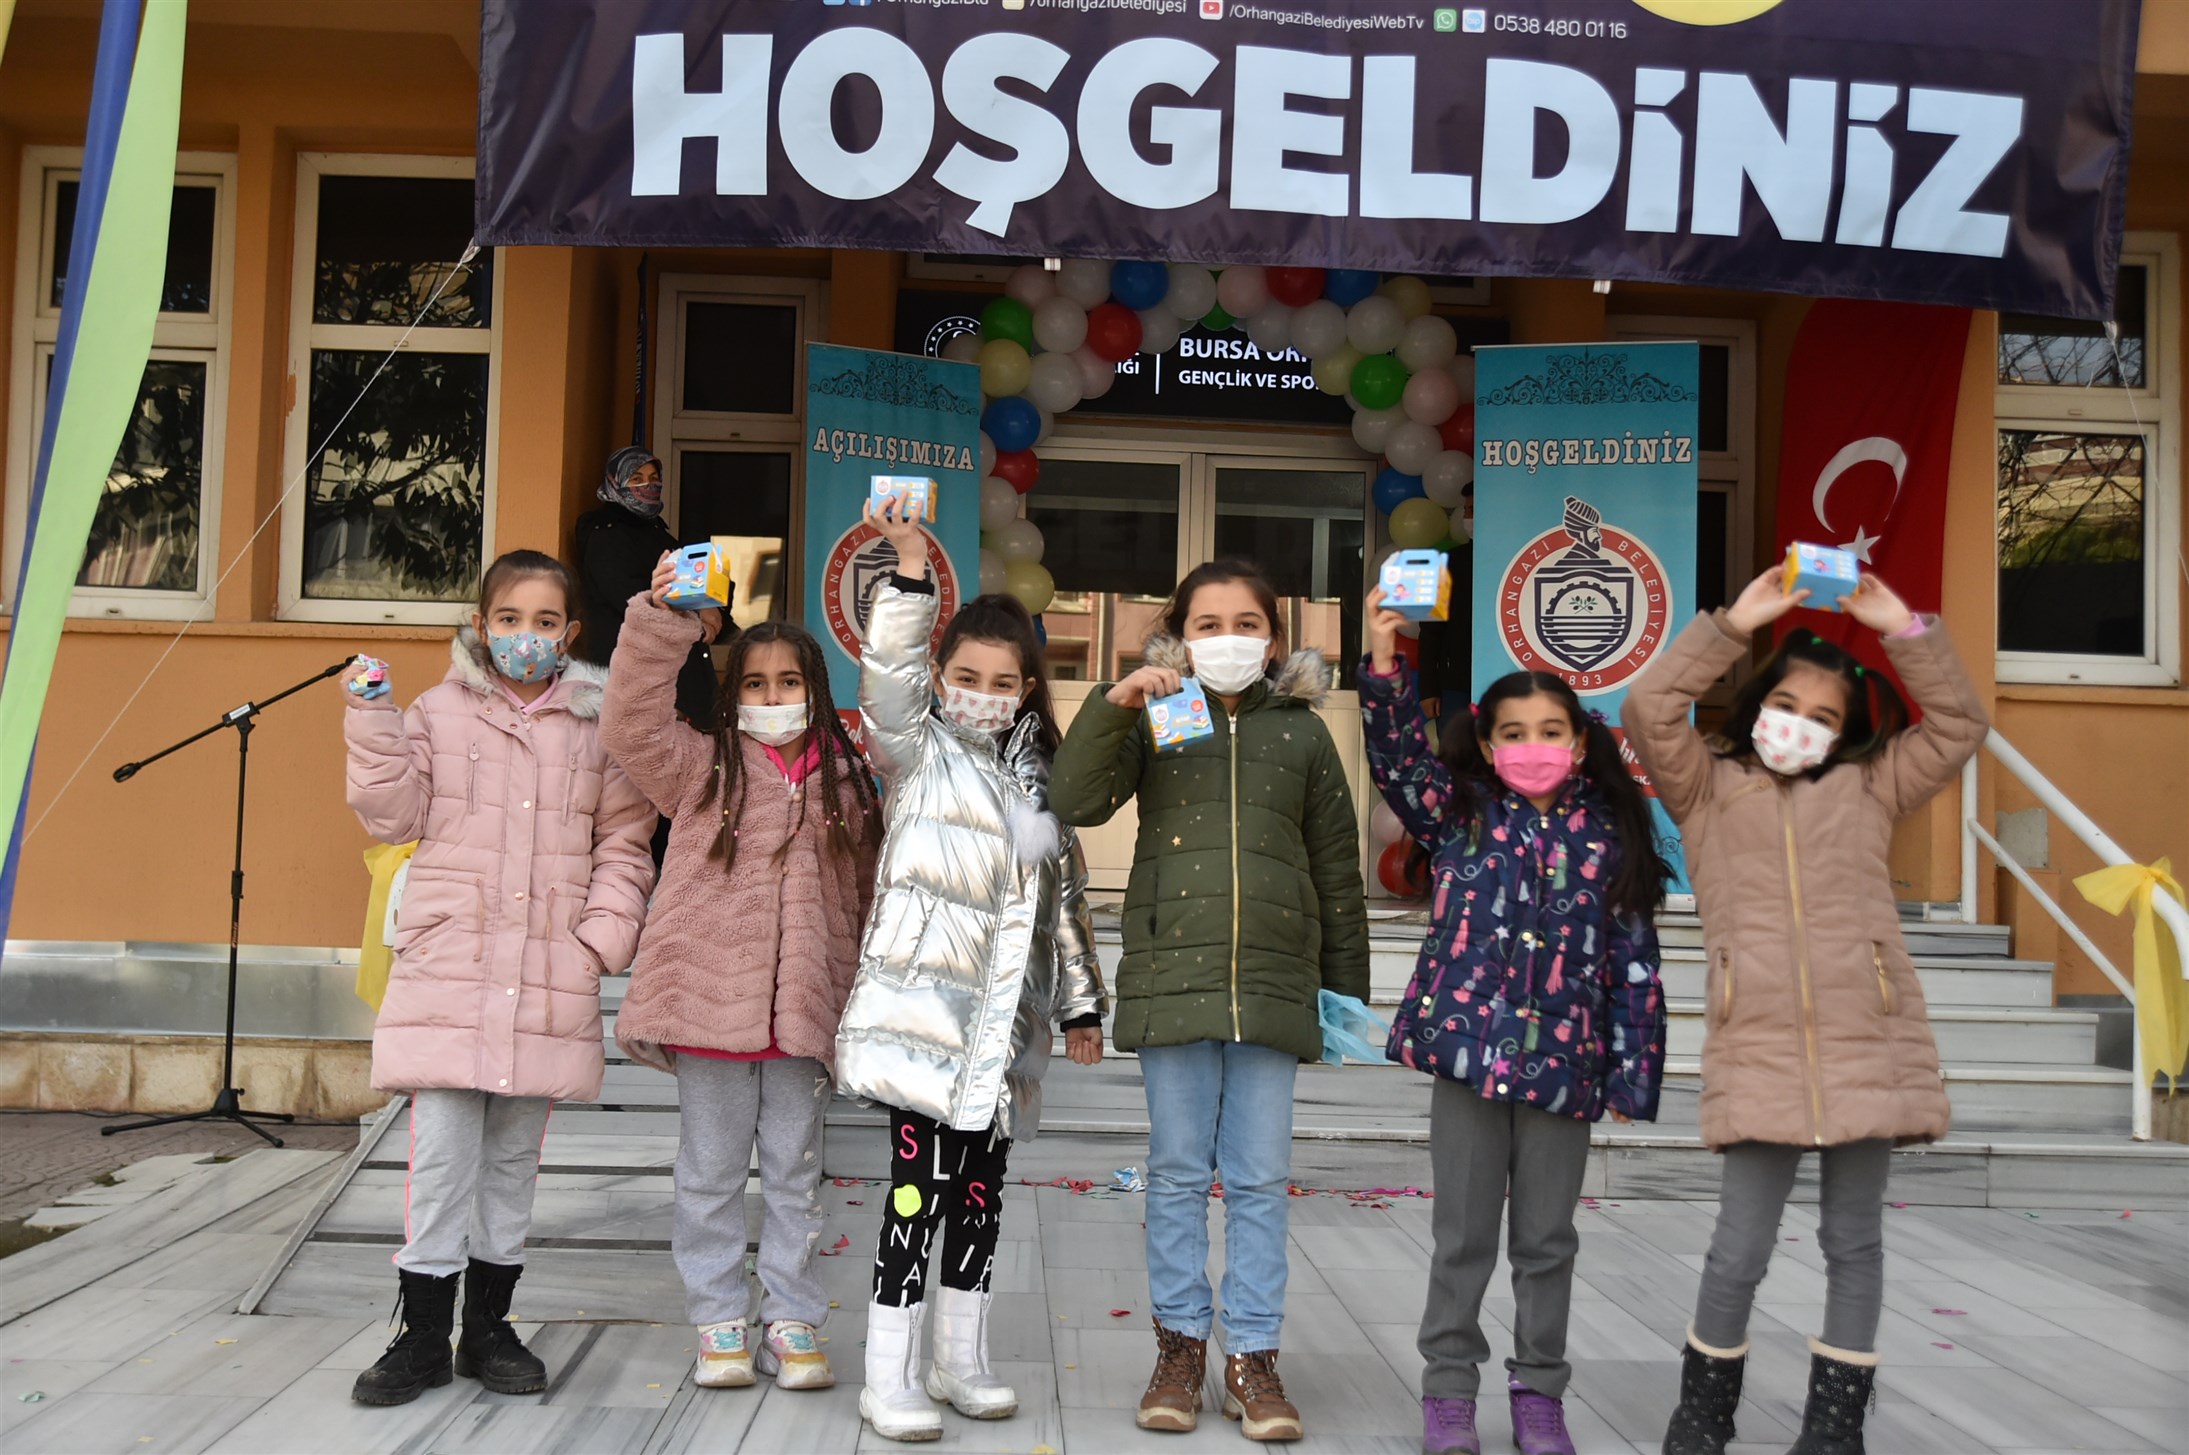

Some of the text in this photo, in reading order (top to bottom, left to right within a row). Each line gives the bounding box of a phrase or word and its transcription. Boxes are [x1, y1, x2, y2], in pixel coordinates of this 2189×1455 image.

[1229, 5, 1424, 32] /OrhangaziBelediyesiWebTv
[1494, 14, 1540, 34] 0538
[1544, 19, 1580, 37] 480
[1180, 337, 1260, 360] BURSA
[1178, 369, 1319, 390] GENÇLİK VE SPO
[813, 426, 975, 470] AÇILIŞIMIZA
[1482, 431, 1692, 475] HOŞGELDİNİZ
